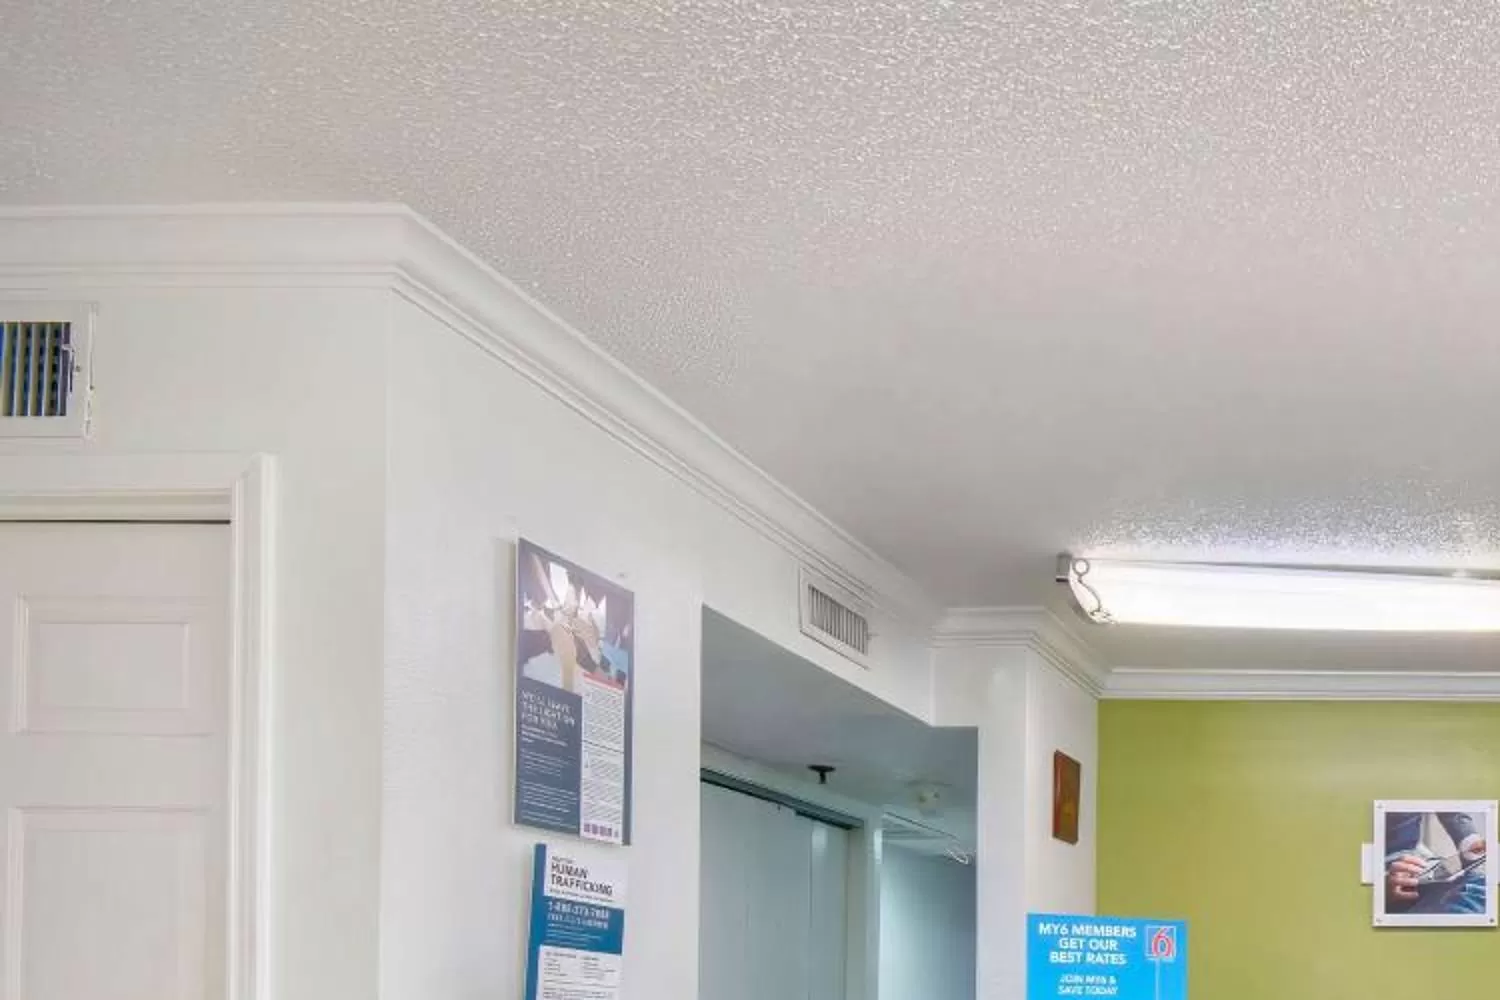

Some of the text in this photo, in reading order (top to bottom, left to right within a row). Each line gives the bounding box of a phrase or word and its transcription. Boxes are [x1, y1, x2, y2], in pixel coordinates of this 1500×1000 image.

[551, 862, 589, 879] HUMAN
[551, 873, 613, 897] TRAFFICKING
[1039, 923, 1137, 938] MY6 MEMBERS
[1059, 938, 1119, 951] GET OUR
[1050, 951, 1128, 965] BEST RATES
[1060, 974, 1084, 984] JOIN
[1057, 985, 1118, 996] SAVE TODAY
